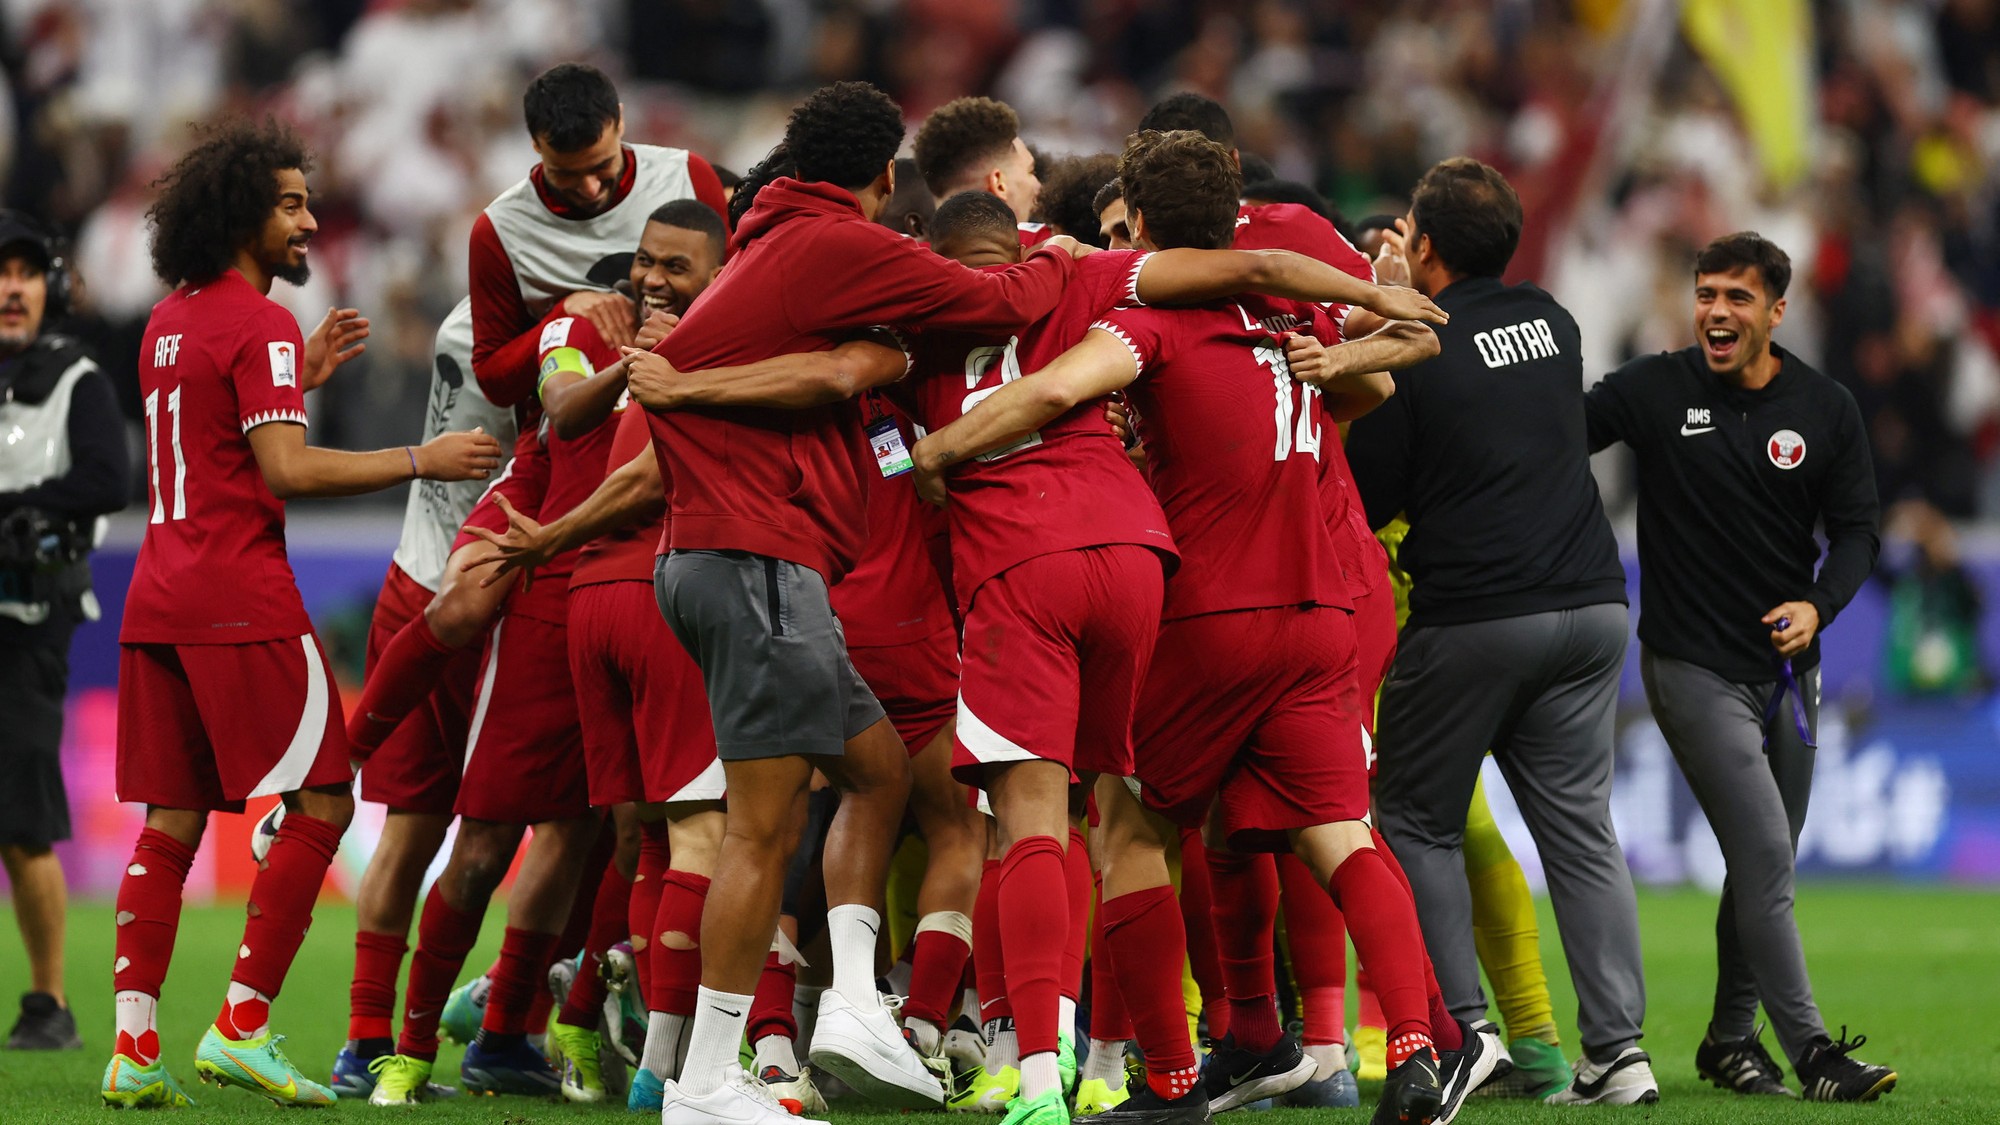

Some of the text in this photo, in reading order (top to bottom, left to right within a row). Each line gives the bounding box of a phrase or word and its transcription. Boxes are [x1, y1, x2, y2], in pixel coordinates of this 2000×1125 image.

[154, 334, 183, 368] AFIF
[1474, 318, 1560, 369] QATAR
[1687, 408, 1711, 424] AMS
[145, 384, 186, 524] 11
